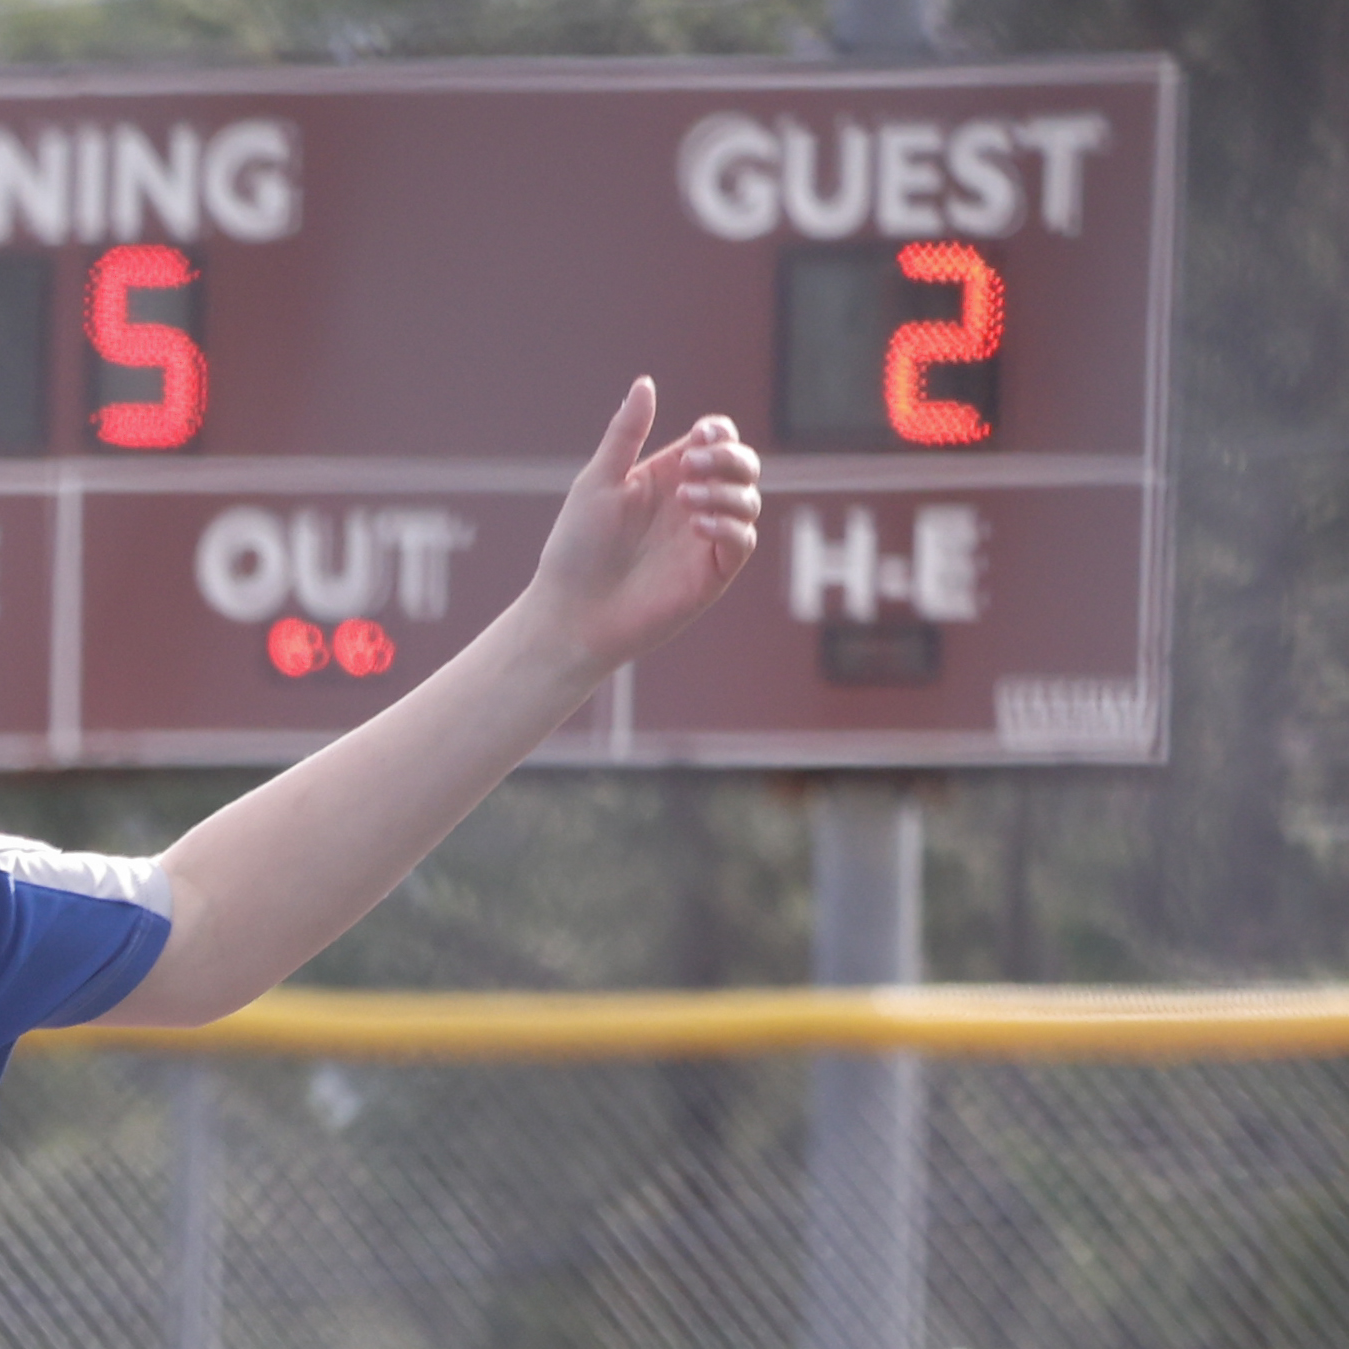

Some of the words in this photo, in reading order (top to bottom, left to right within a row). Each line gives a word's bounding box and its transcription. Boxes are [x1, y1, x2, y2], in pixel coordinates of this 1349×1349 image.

[677, 110, 1110, 240] GUEST
[84, 244, 207, 449] 5
[883, 241, 1004, 445] 2
[195, 505, 471, 622] OUT
